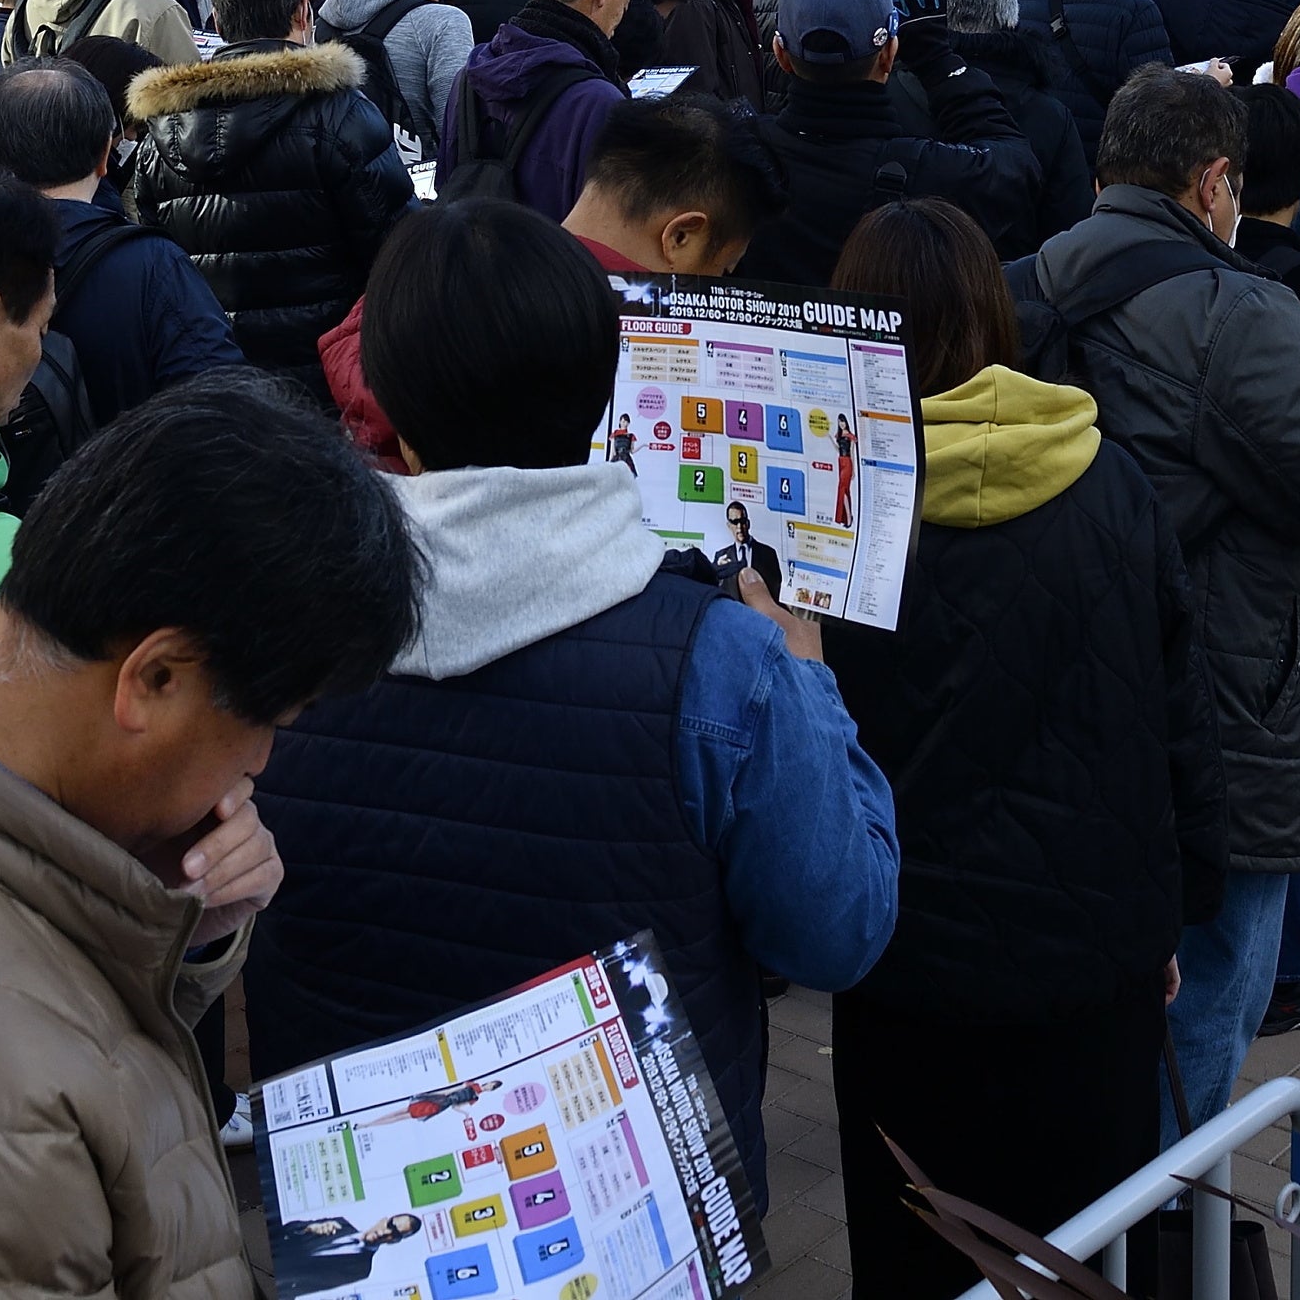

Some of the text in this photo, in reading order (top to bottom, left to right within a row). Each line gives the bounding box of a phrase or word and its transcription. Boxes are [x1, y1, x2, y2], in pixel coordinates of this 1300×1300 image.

[710, 286, 724, 295] 11th
[669, 292, 801, 318] OSAKA MOTOR SHOW 2019
[803, 301, 857, 328] GUIDE
[860, 308, 902, 333] MAP
[621, 321, 684, 334] FLOOR GUIDE
[697, 404, 705, 418] 5
[739, 410, 747, 424] 4
[780, 416, 787, 430] 6
[739, 453, 747, 467] 3
[696, 471, 704, 485] 2
[781, 479, 789, 493] 6
[604, 1023, 636, 1083] FLOOR GUIDE
[653, 1043, 714, 1184] OSAKA MOTOR SHOW 2019
[521, 1140, 543, 1159] 5
[429, 1168, 449, 1185] 2
[532, 1188, 553, 1205] 4
[472, 1205, 493, 1222] 3
[696, 1175, 754, 1289] GUIDE MAP
[545, 1240, 564, 1255] 6
[456, 1263, 478, 1282] 6
